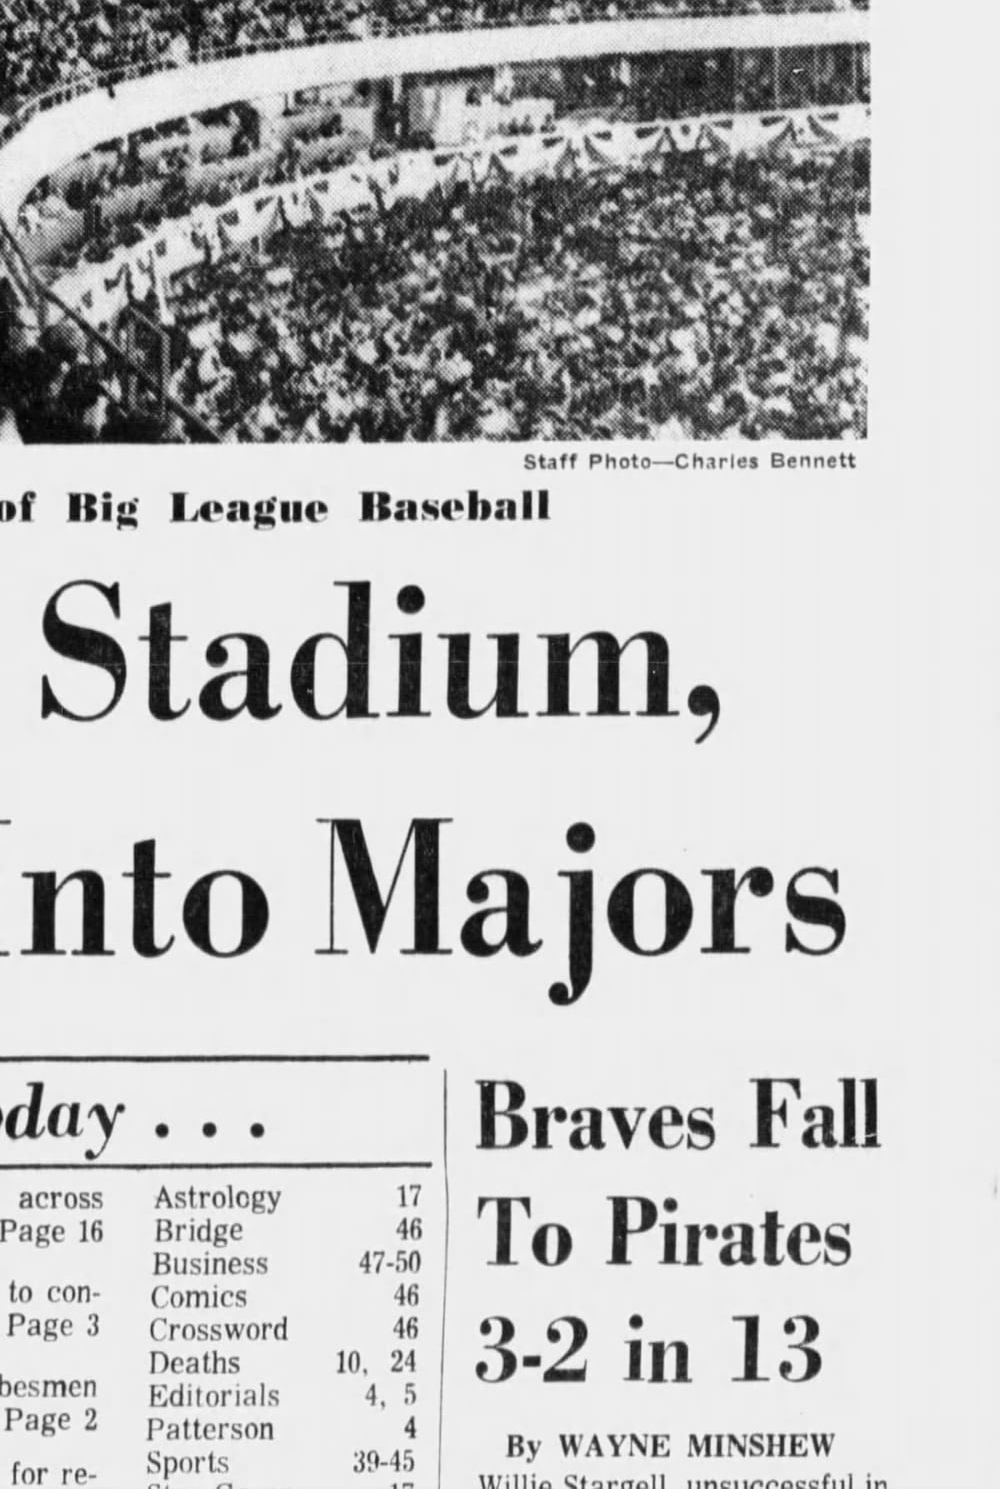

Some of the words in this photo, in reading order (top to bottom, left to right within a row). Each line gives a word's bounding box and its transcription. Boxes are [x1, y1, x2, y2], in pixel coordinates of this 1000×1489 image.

[523, 452, 578, 471] Staff
[770, 452, 856, 469] Bennett
[68, 491, 139, 531] Big
[171, 492, 328, 530] League
[361, 489, 549, 522] Baseball
[41, 579, 721, 744] Stadium,
[314, 817, 846, 1006] Majors
[475, 1079, 716, 1151] Braves
[749, 1077, 881, 1149] Fall
[18, 1191, 103, 1210] across
[154, 1184, 282, 1214] Astrology
[398, 1184, 422, 1208] 17
[0, 1218, 65, 1248] Page
[79, 1219, 104, 1243] 16
[155, 1218, 243, 1248] Bridge
[396, 1217, 423, 1241] 46
[477, 1196, 573, 1267] To
[606, 1196, 852, 1267] Pirates
[153, 1251, 268, 1276] Business
[359, 1250, 422, 1274] 47-50
[9, 1280, 33, 1303] to
[47, 1285, 100, 1304] con-
[151, 1284, 247, 1309] Comics
[394, 1283, 419, 1306] 46
[7, 1312, 73, 1342] Page
[87, 1313, 100, 1337] 3
[149, 1315, 288, 1341] Crossword
[393, 1316, 419, 1340] 46
[150, 1350, 241, 1375] Deaths
[337, 1350, 368, 1375] 10,
[390, 1349, 416, 1373] 24
[475, 1316, 588, 1383] 3-2
[625, 1314, 692, 1383] in
[732, 1315, 822, 1383] 13
[150, 1382, 280, 1408] Editorials
[365, 1383, 386, 1408] 4,
[404, 1382, 417, 1405] 5
[5, 1407, 71, 1437] Page
[84, 1407, 98, 1432] 2
[147, 1418, 274, 1441] Patterson
[404, 1415, 417, 1439] 4
[506, 1434, 542, 1464] By
[559, 1433, 671, 1458] WAYNE
[687, 1432, 835, 1458] MINSHEW
[12, 1461, 49, 1486] for
[62, 1467, 97, 1486] re-
[146, 1450, 229, 1481] Sports
[353, 1449, 415, 1473] 39-45
